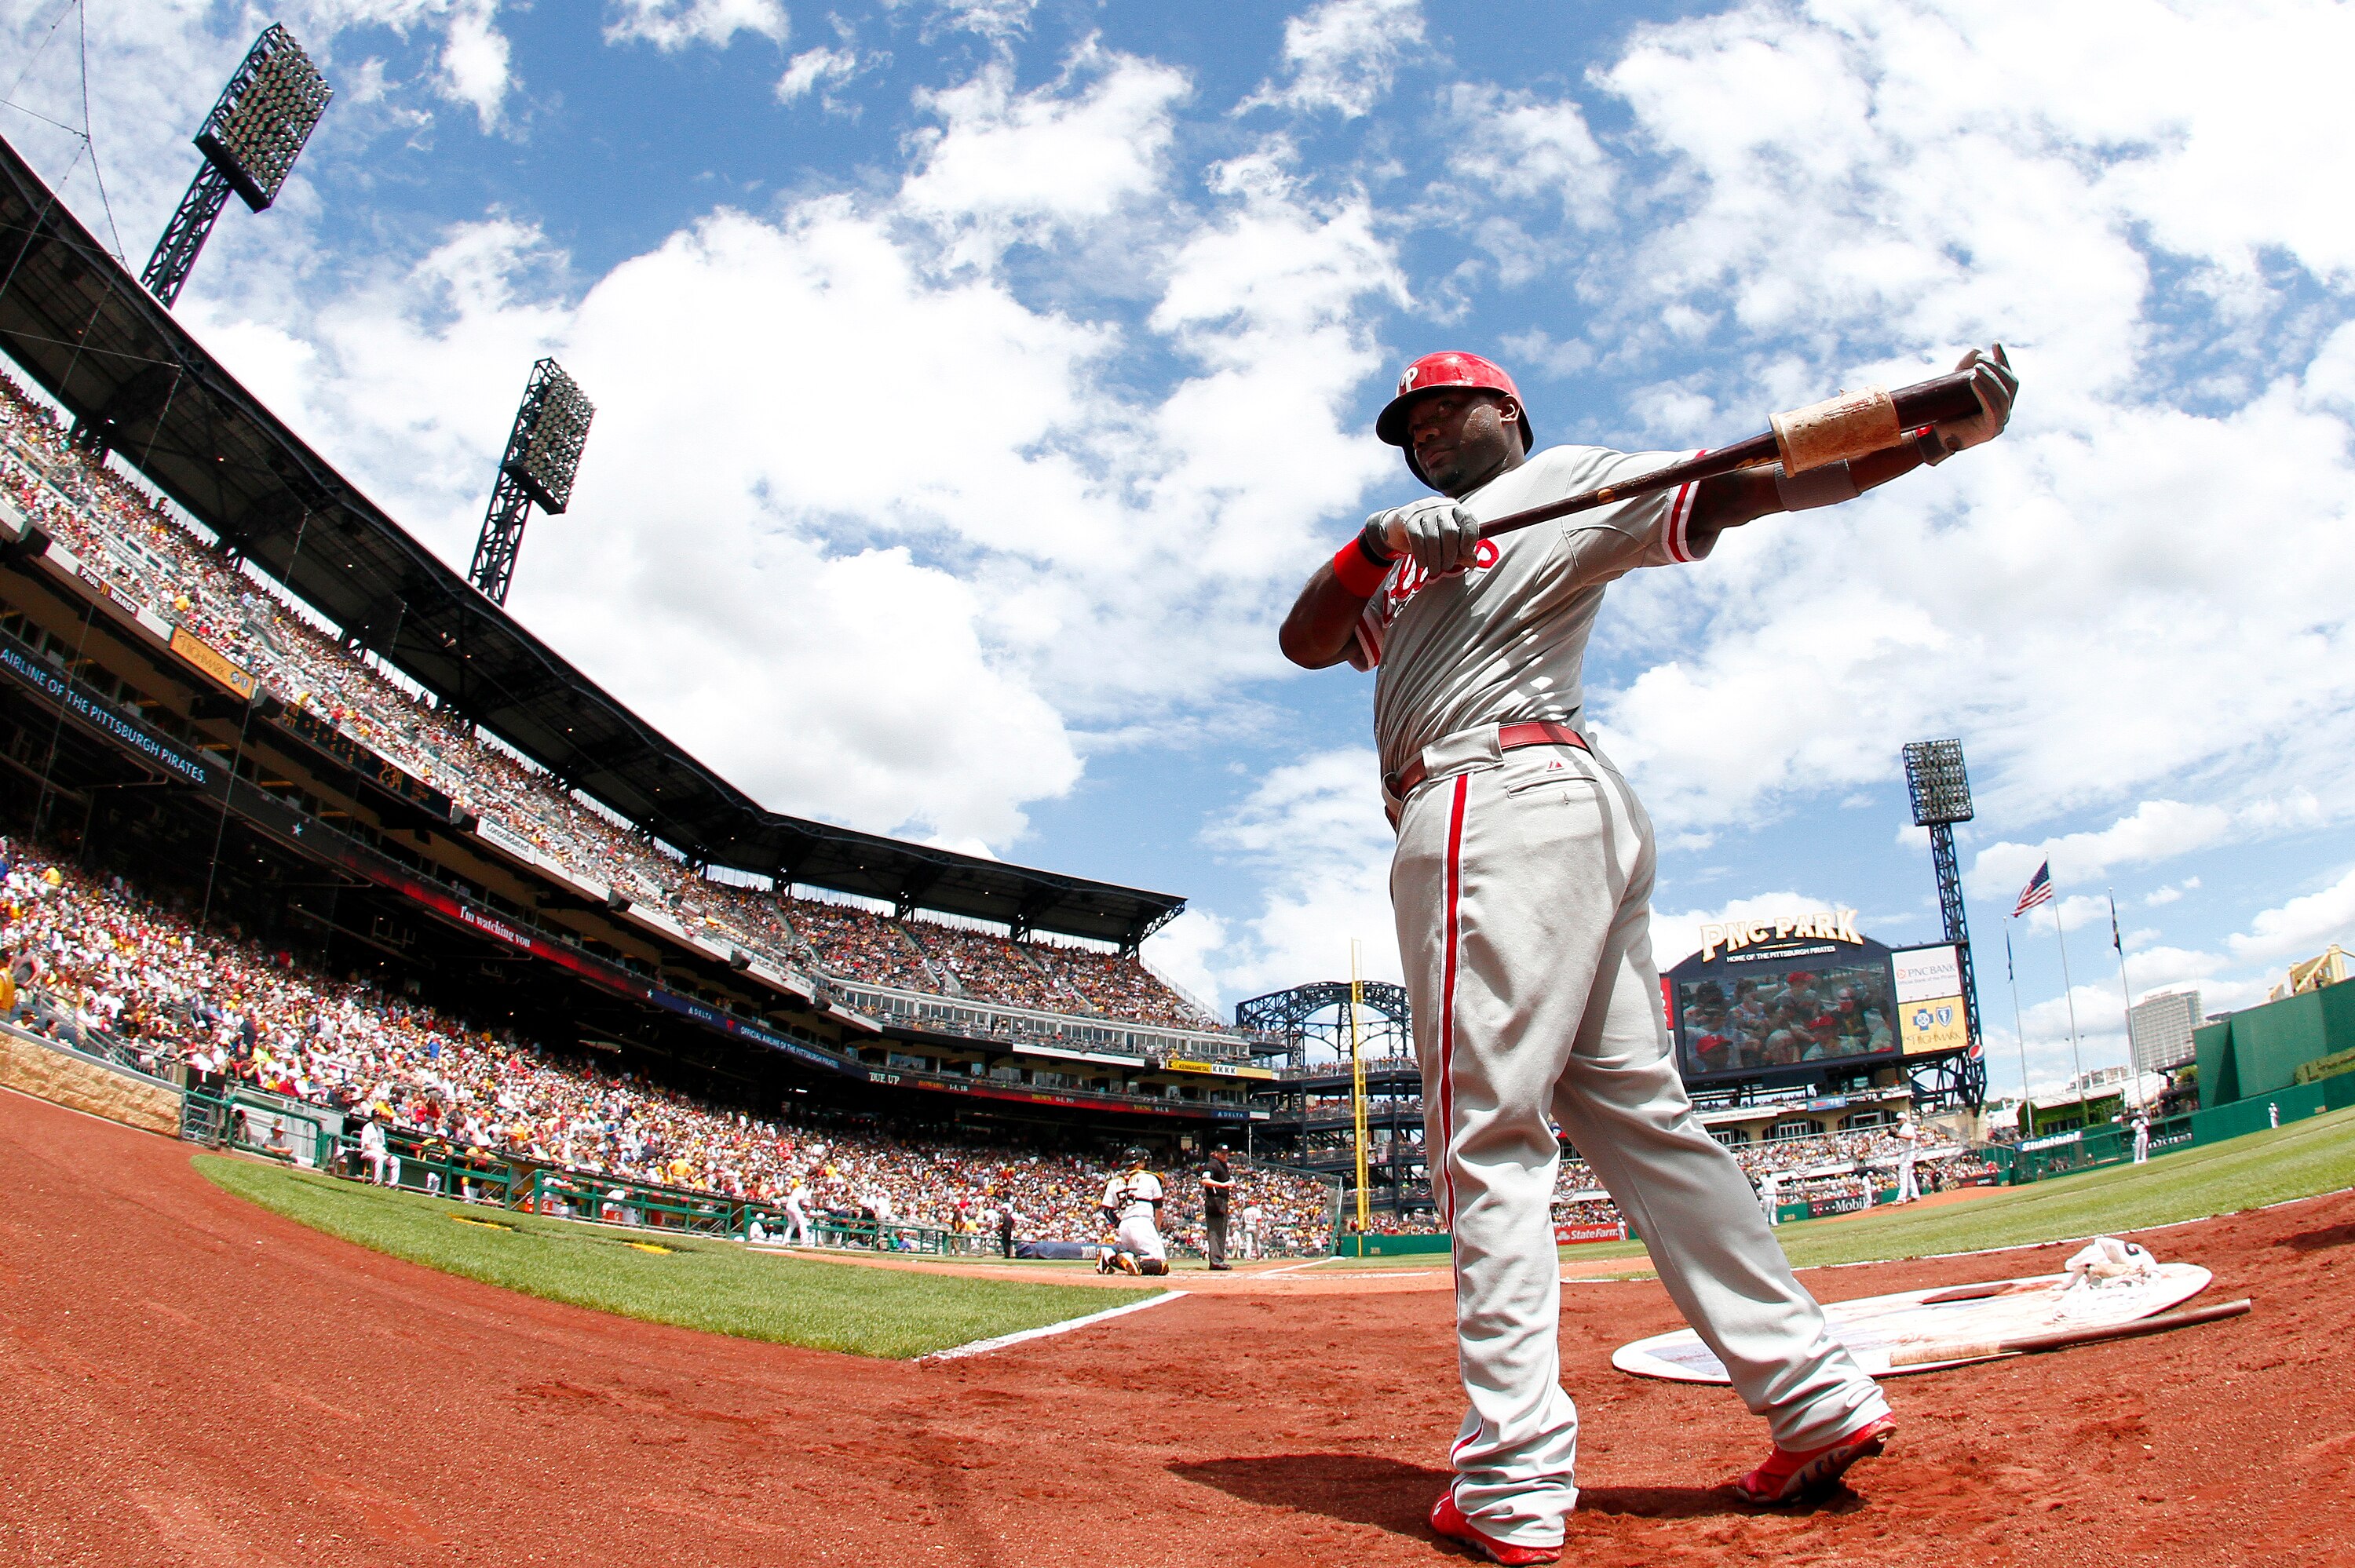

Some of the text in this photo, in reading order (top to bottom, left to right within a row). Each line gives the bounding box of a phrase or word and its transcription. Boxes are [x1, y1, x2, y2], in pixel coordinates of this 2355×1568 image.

[79, 567, 137, 614] PAUL WANER
[0, 648, 47, 687] AIRLINE
[48, 679, 65, 696] OF
[67, 690, 89, 713] THE
[89, 706, 160, 756] PITTSBURGH
[486, 822, 530, 852] Consolidated
[460, 905, 531, 948] I'm watching you
[1700, 910, 1864, 962] PNC PARK
[1727, 953, 1746, 962] HOME
[1746, 952, 1755, 961] OF
[1770, 948, 1809, 958] PITTSBURGH
[1809, 945, 1836, 954] PIRATES
[1908, 962, 1956, 978] PNC BANK
[693, 1008, 712, 1020] DELTA
[869, 1072, 900, 1085] DUE UP
[1813, 1203, 1823, 1216] T
[1835, 1197, 1865, 1212] Mobil
[1571, 1230, 1595, 1240] State
